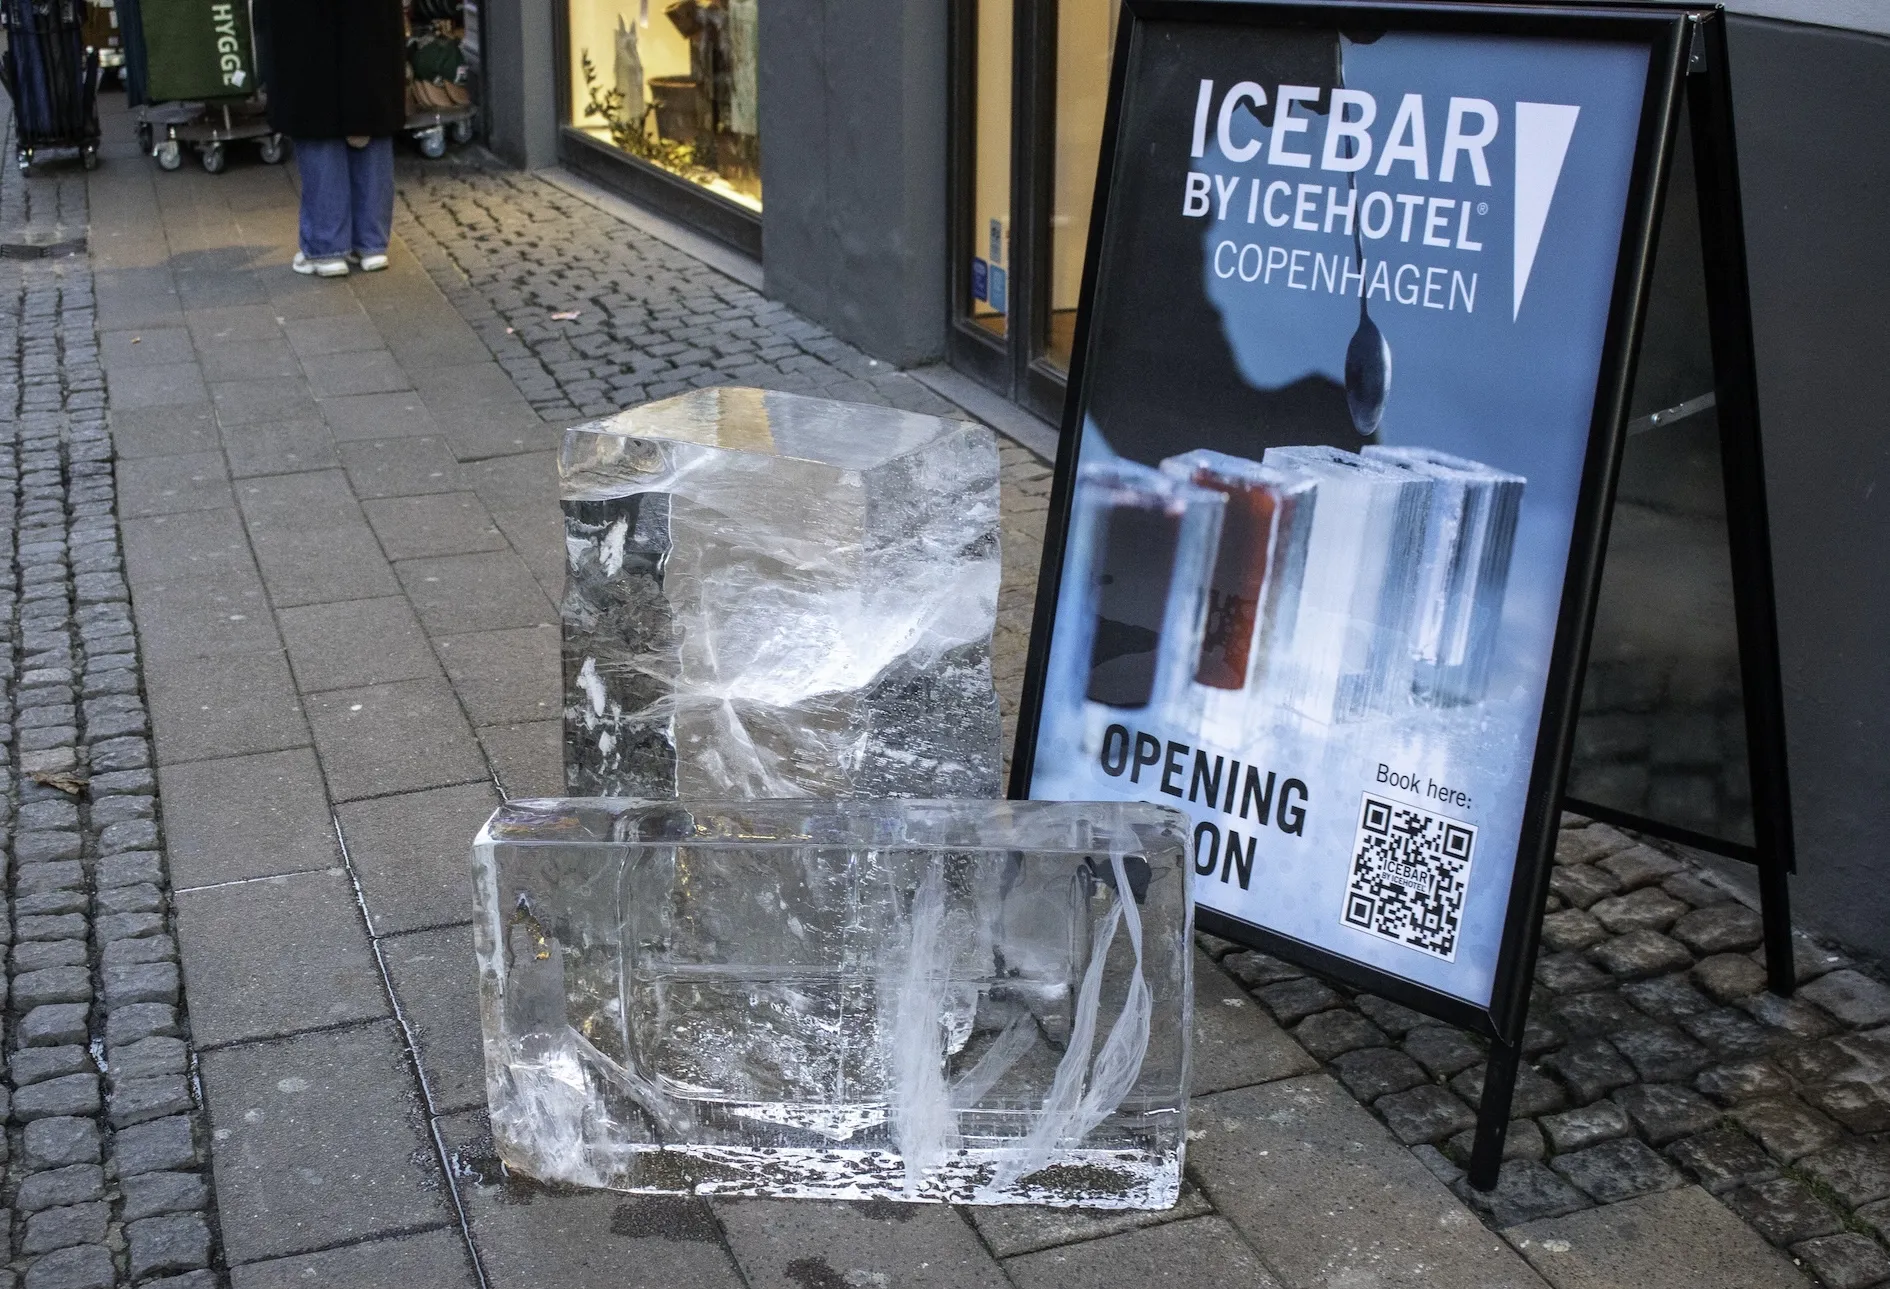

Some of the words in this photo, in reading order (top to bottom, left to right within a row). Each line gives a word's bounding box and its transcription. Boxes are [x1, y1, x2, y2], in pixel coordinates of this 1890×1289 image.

[1191, 79, 1499, 187] ICEBAR
[1182, 171, 1240, 221] BY
[1213, 240, 1478, 313] COPENHAGEN
[1101, 723, 1309, 837] OPENING
[1376, 763, 1420, 794] Book
[1426, 777, 1473, 809] here:
[1381, 871, 1392, 881] BY
[1383, 859, 1428, 885] ICEBAR
